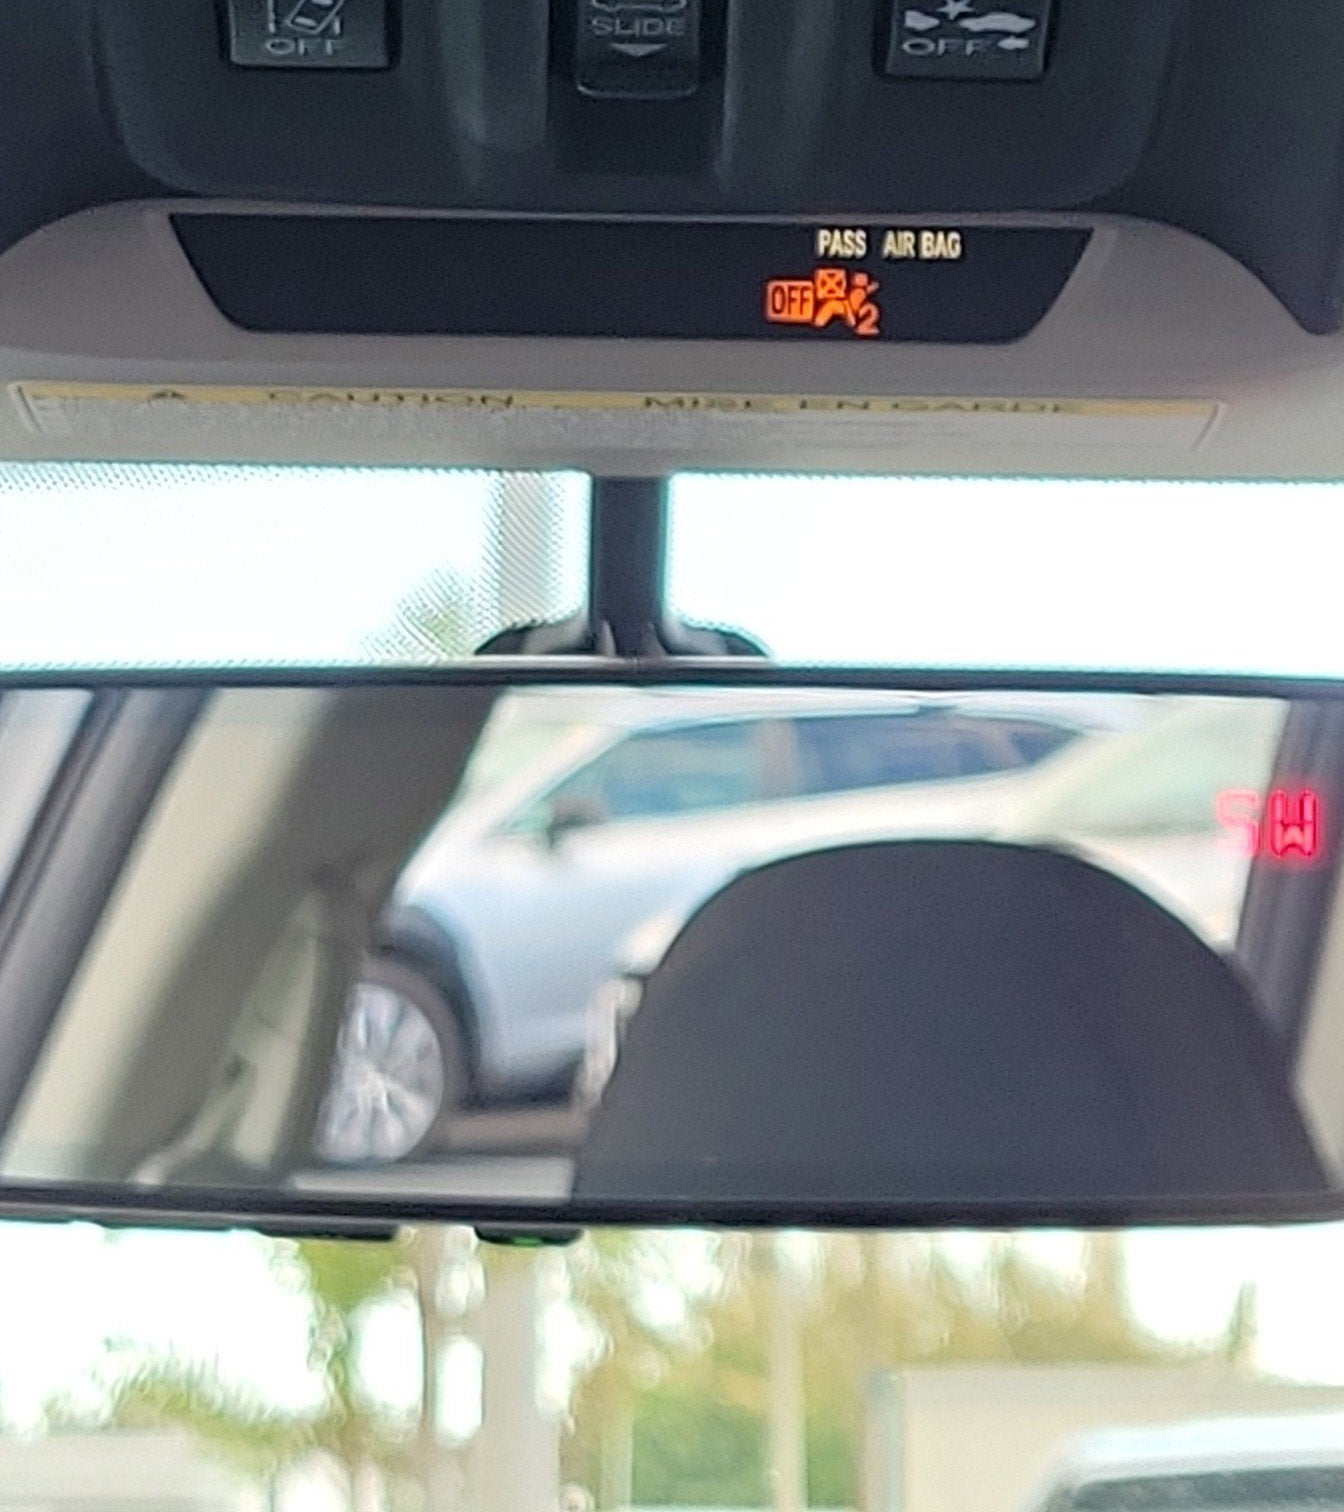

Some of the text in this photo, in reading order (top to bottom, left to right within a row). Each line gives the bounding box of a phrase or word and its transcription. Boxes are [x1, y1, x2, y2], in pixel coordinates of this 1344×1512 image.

[591, 18, 686, 37] SLIDE
[265, 38, 342, 55] OFF
[902, 37, 990, 56] OFF
[816, 228, 962, 259] PASS AIR BAG
[770, 284, 814, 315] OFF
[1215, 787, 1318, 858] SW
